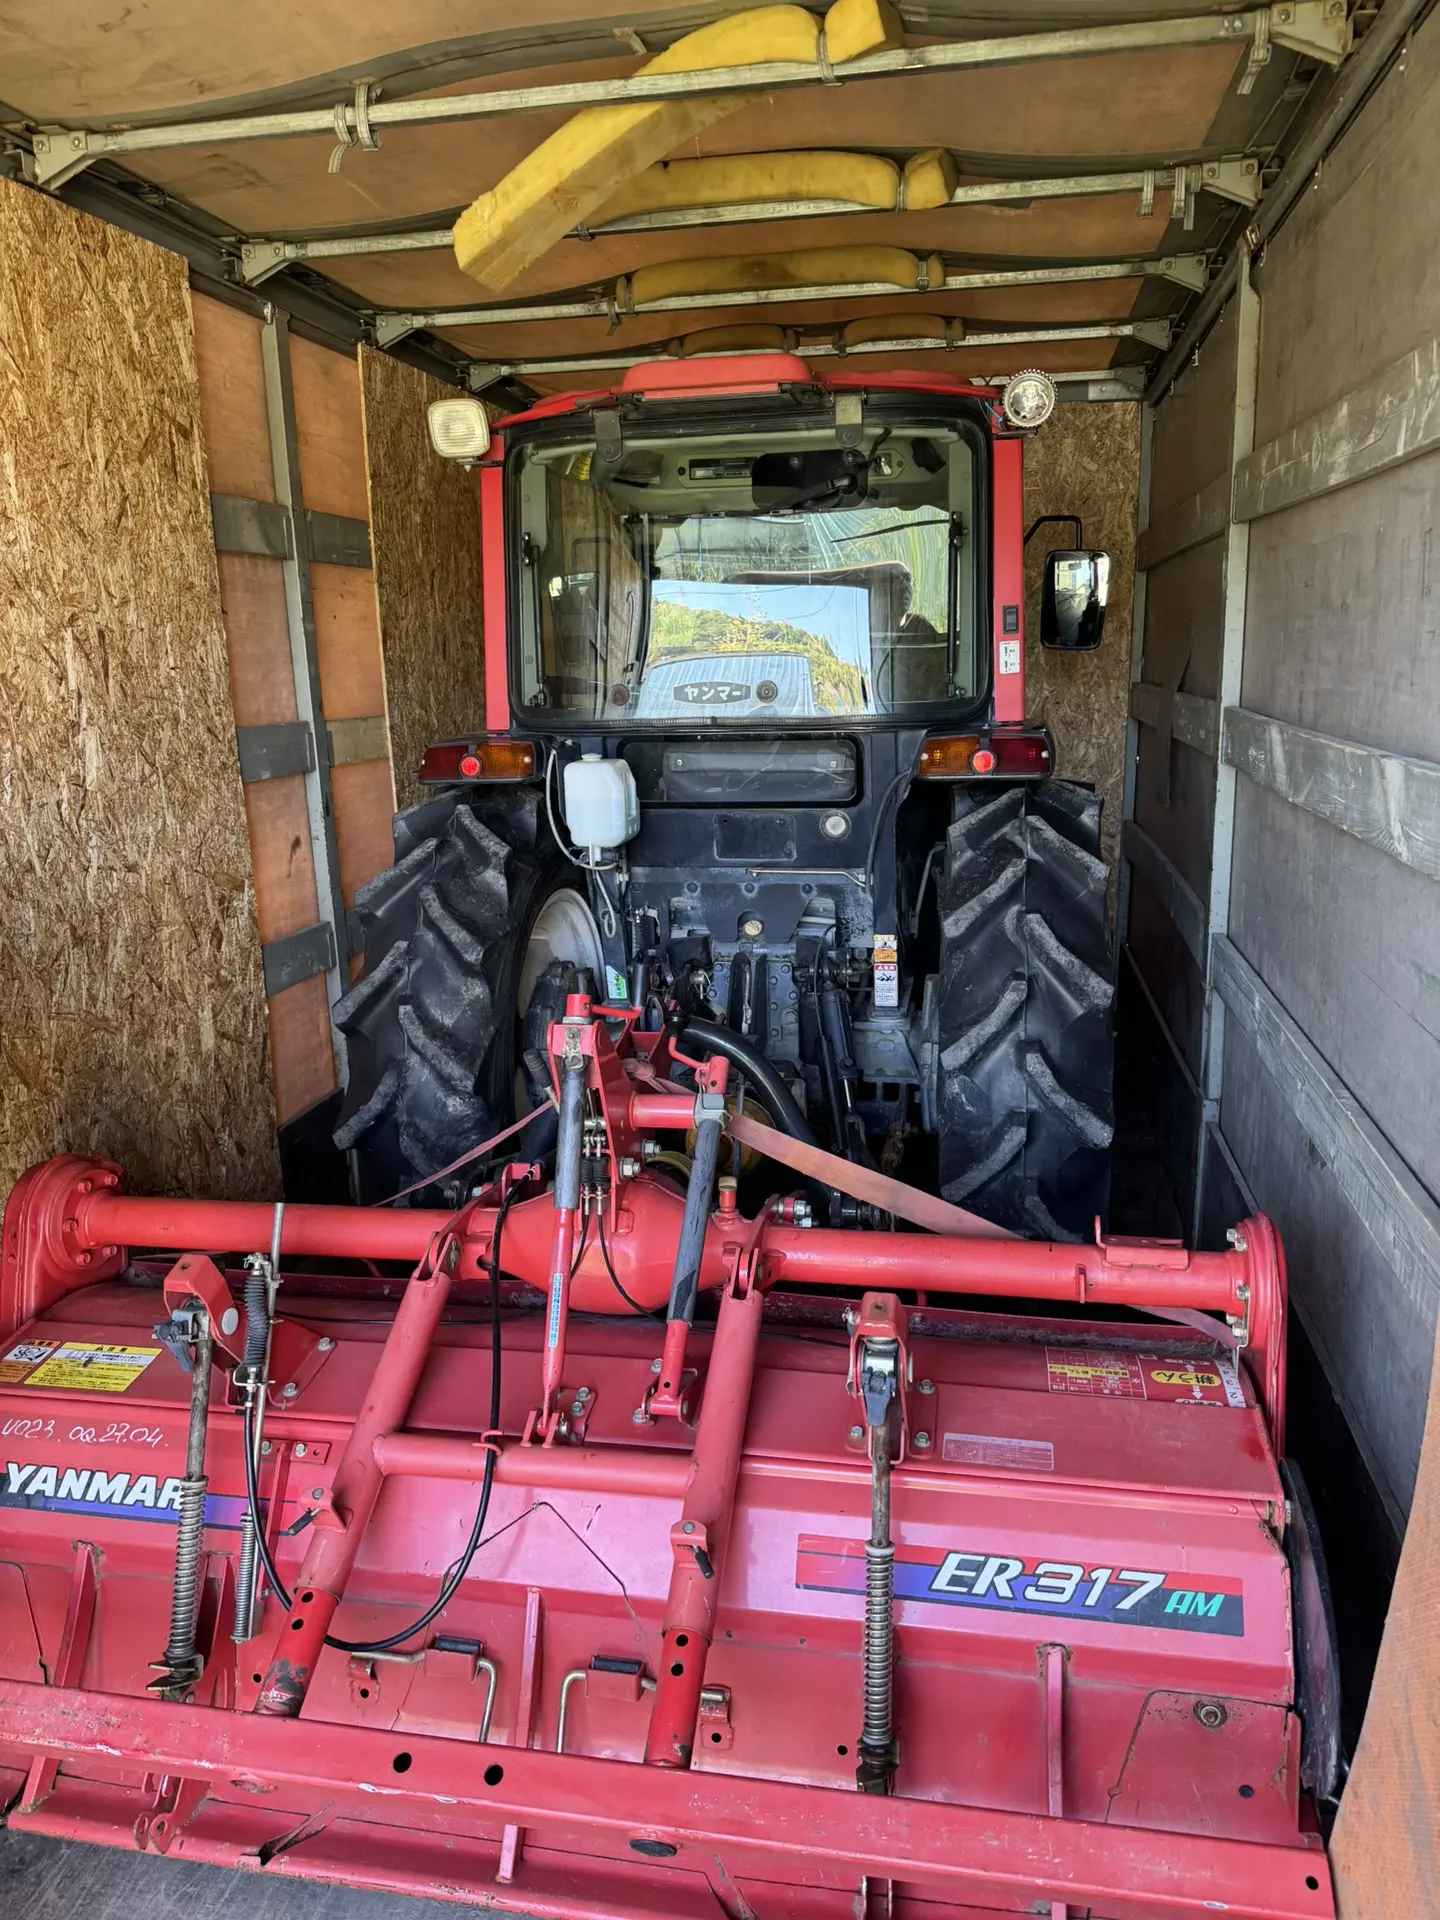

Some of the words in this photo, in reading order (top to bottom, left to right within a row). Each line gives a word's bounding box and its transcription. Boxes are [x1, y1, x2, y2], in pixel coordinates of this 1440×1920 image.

[683, 685, 742, 701] ヤンマー
[1156, 1372, 1215, 1385] 耕うん
[1229, 1391, 1238, 1399] 2
[1164, 1590, 1225, 1617] AM
